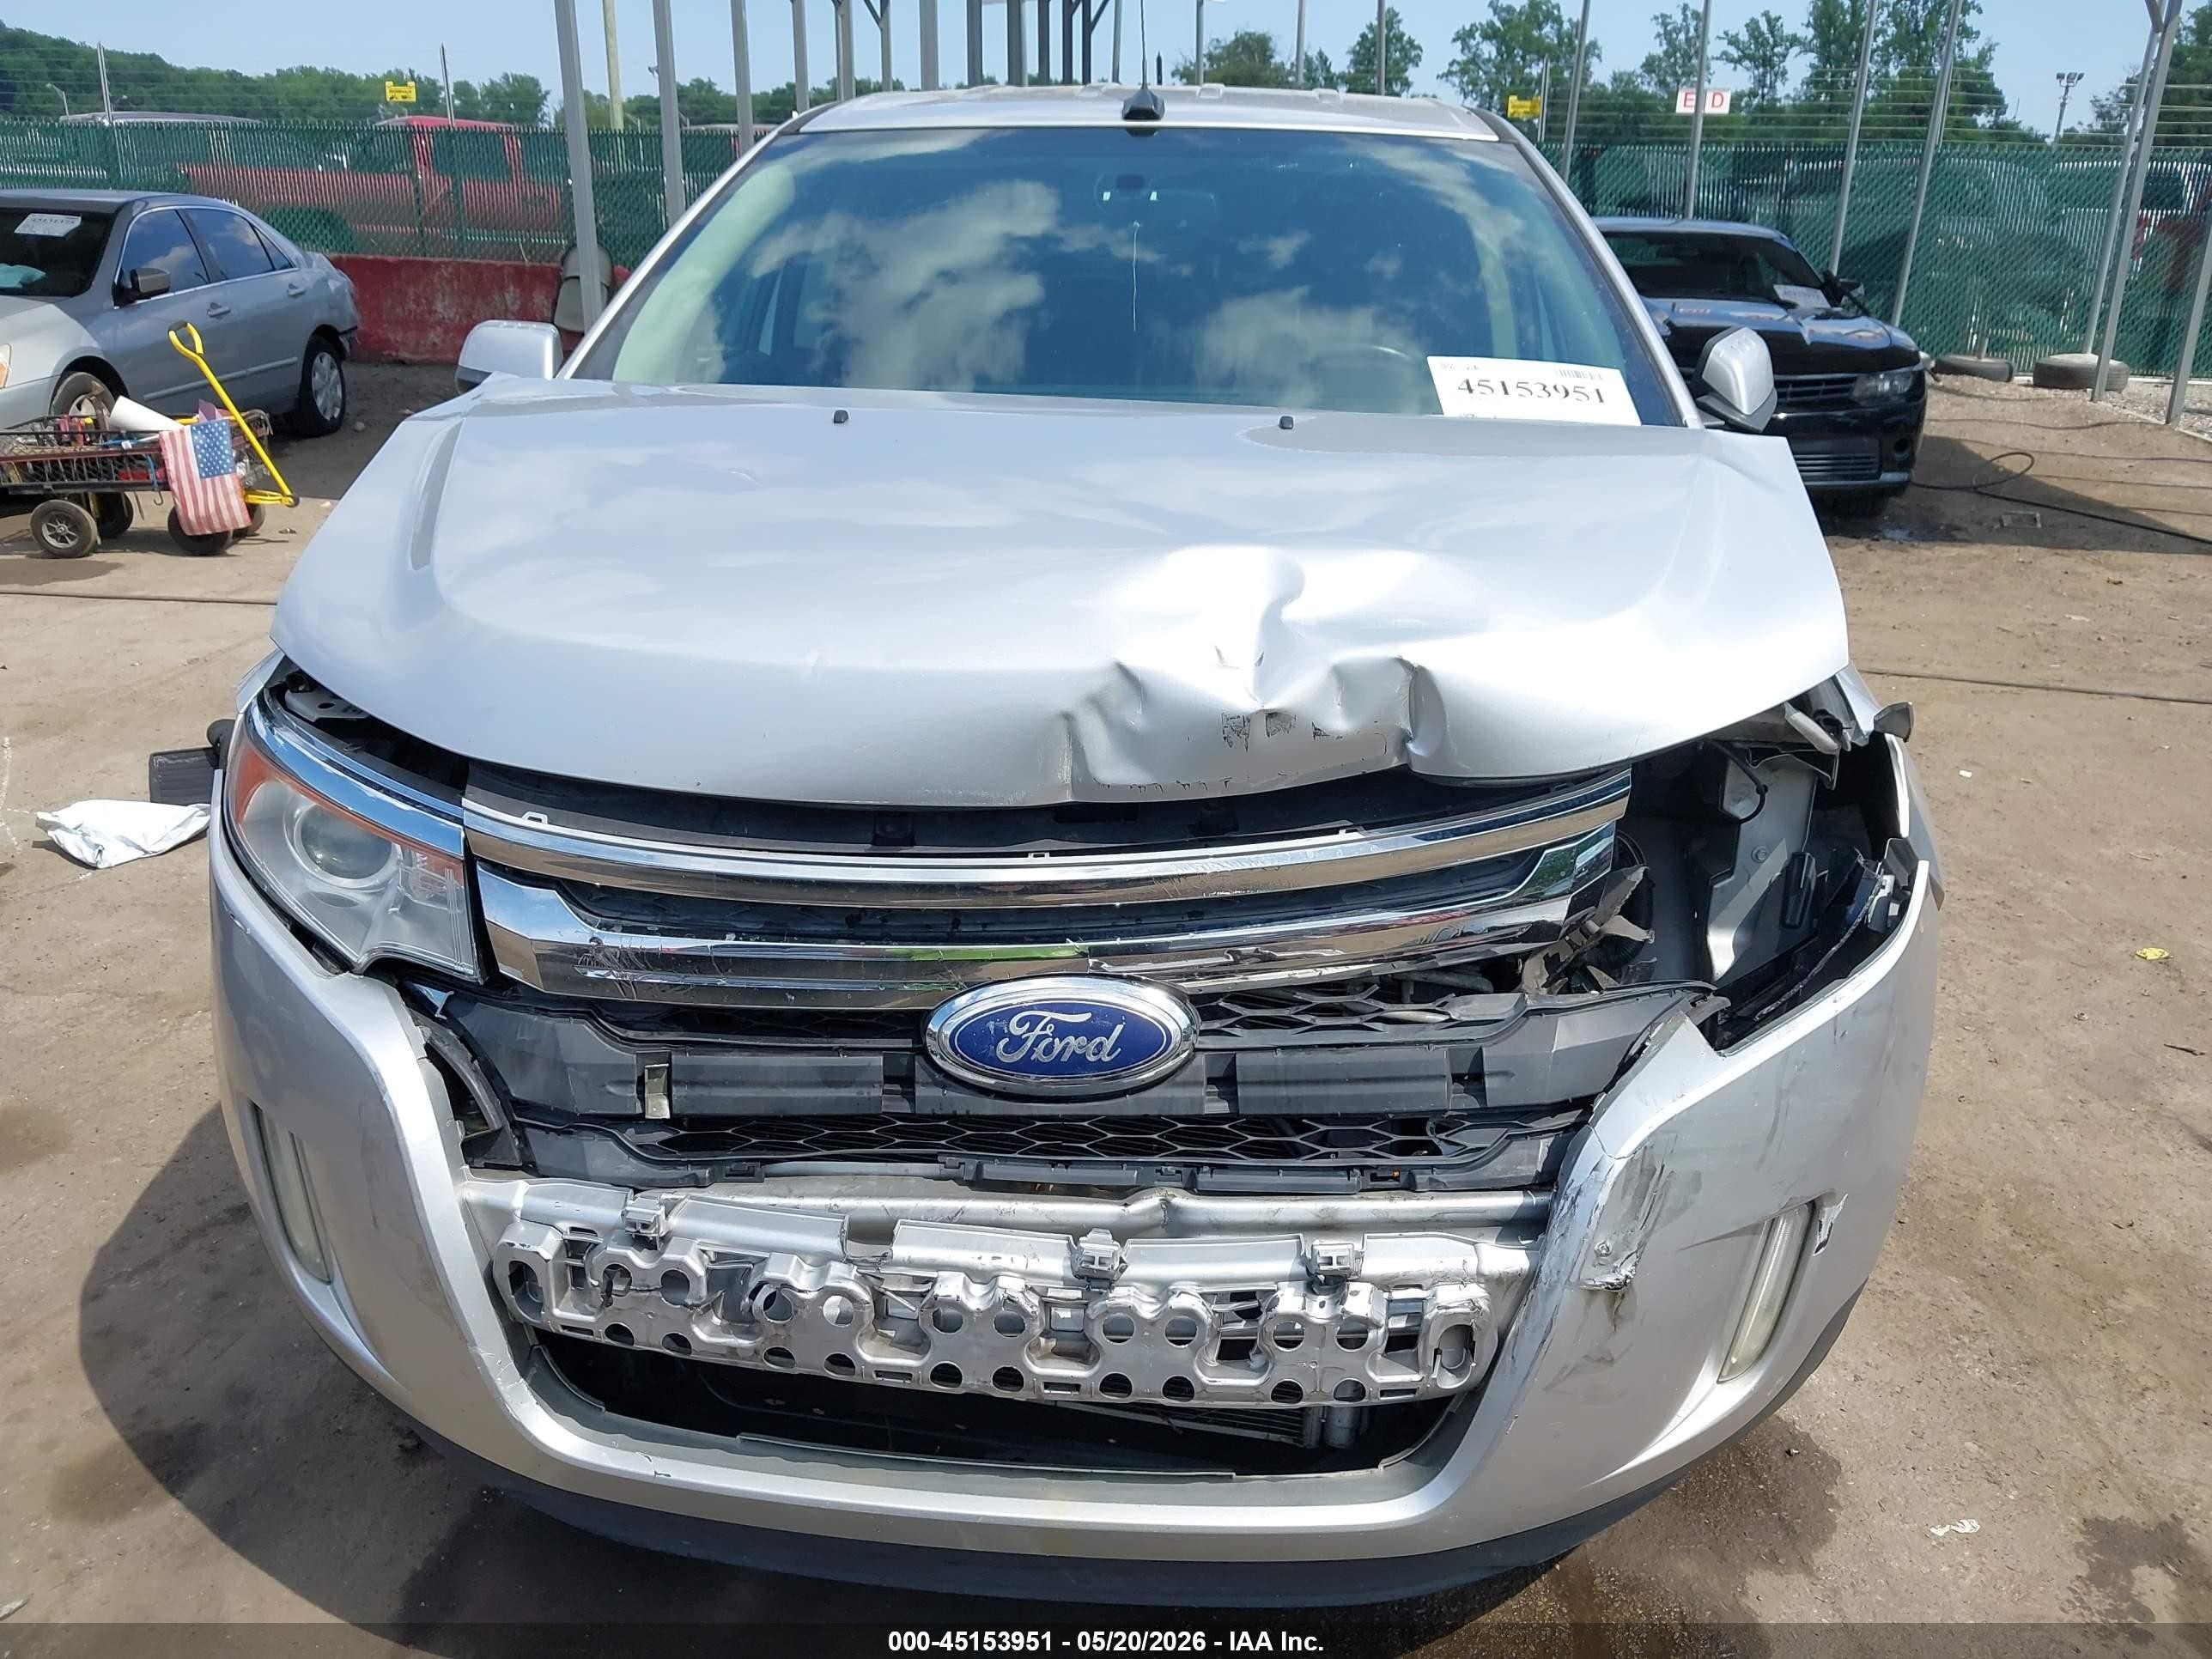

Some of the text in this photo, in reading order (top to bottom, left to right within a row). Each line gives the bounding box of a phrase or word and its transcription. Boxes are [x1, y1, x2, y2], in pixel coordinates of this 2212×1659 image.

[1683, 91, 1724, 108] ED
[1457, 378, 1605, 404] 45153951
[995, 1010, 1125, 1063] Ford
